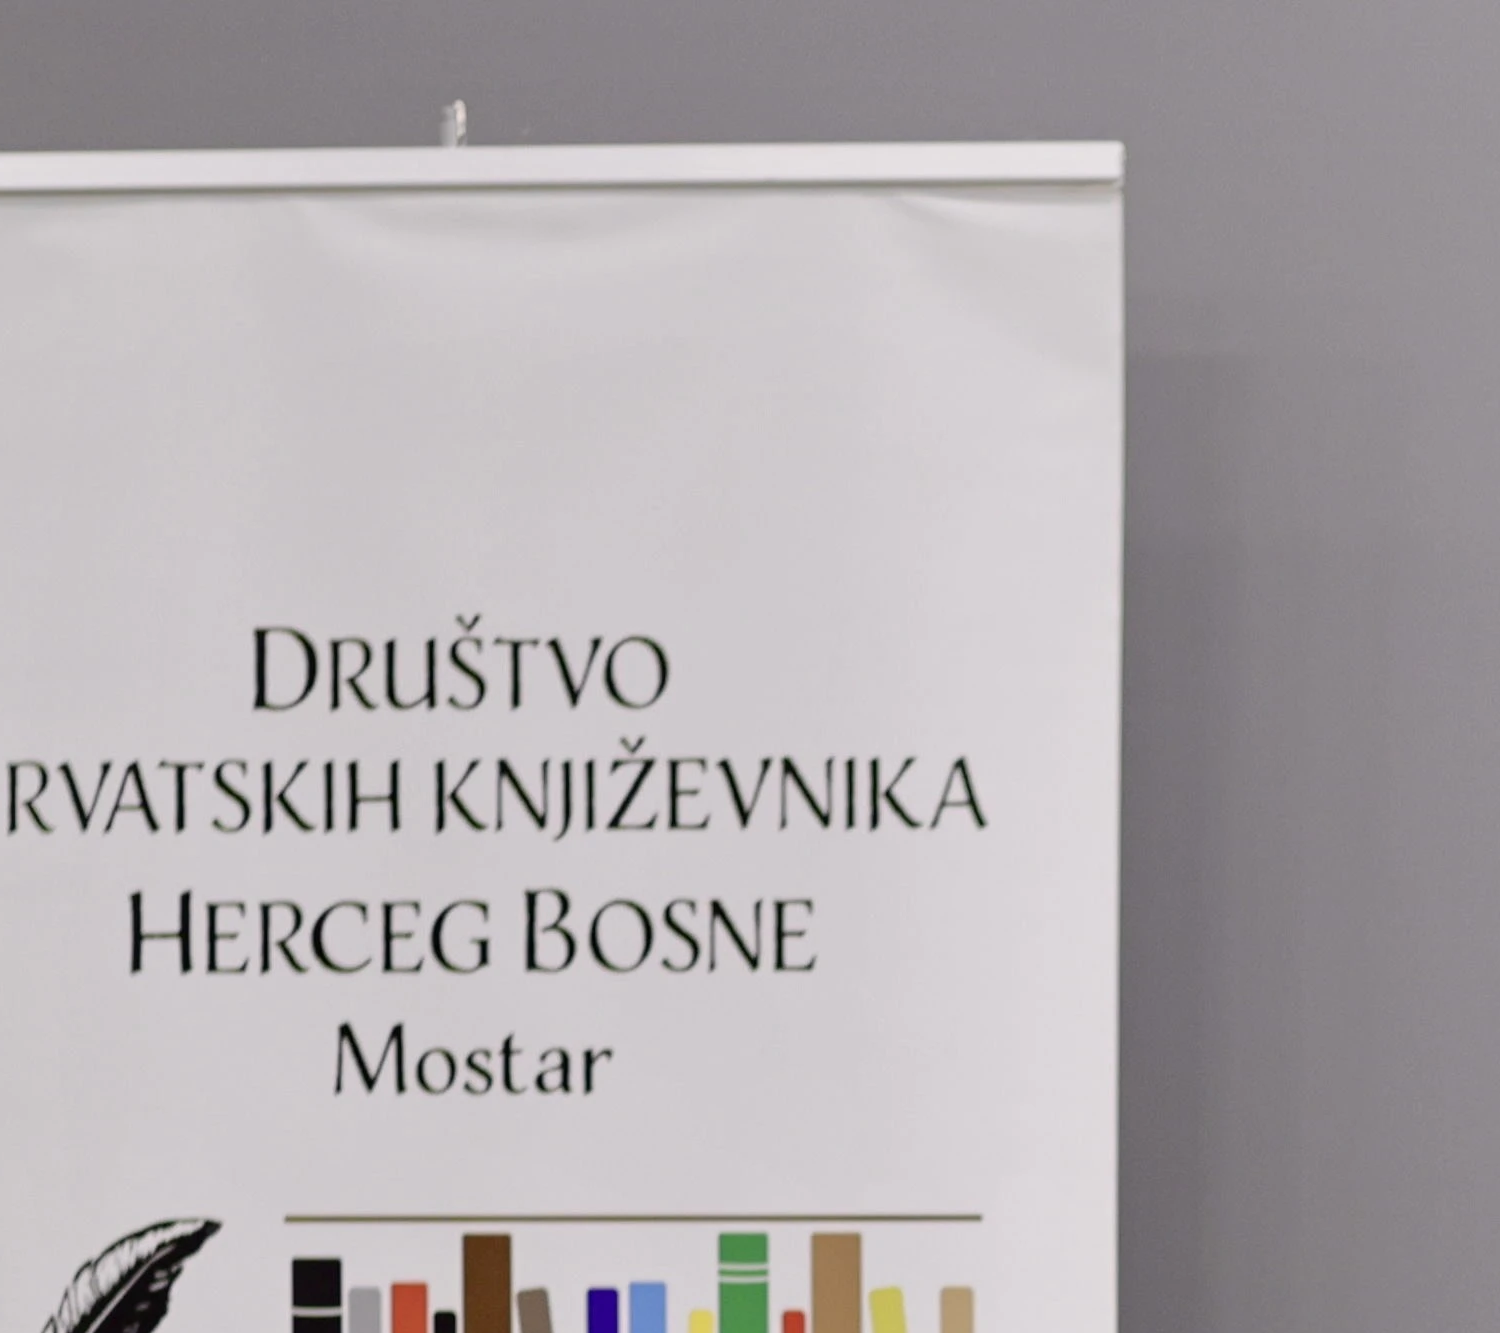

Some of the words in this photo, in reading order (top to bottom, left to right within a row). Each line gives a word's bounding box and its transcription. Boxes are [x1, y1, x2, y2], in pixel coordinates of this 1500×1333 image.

[253, 614, 670, 712] DRUŠTVO
[434, 736, 988, 841] KNJIŽEVNIKA
[129, 889, 490, 975] HERCEG
[524, 888, 816, 974] BOSNE
[334, 1021, 613, 1095] Mostar
